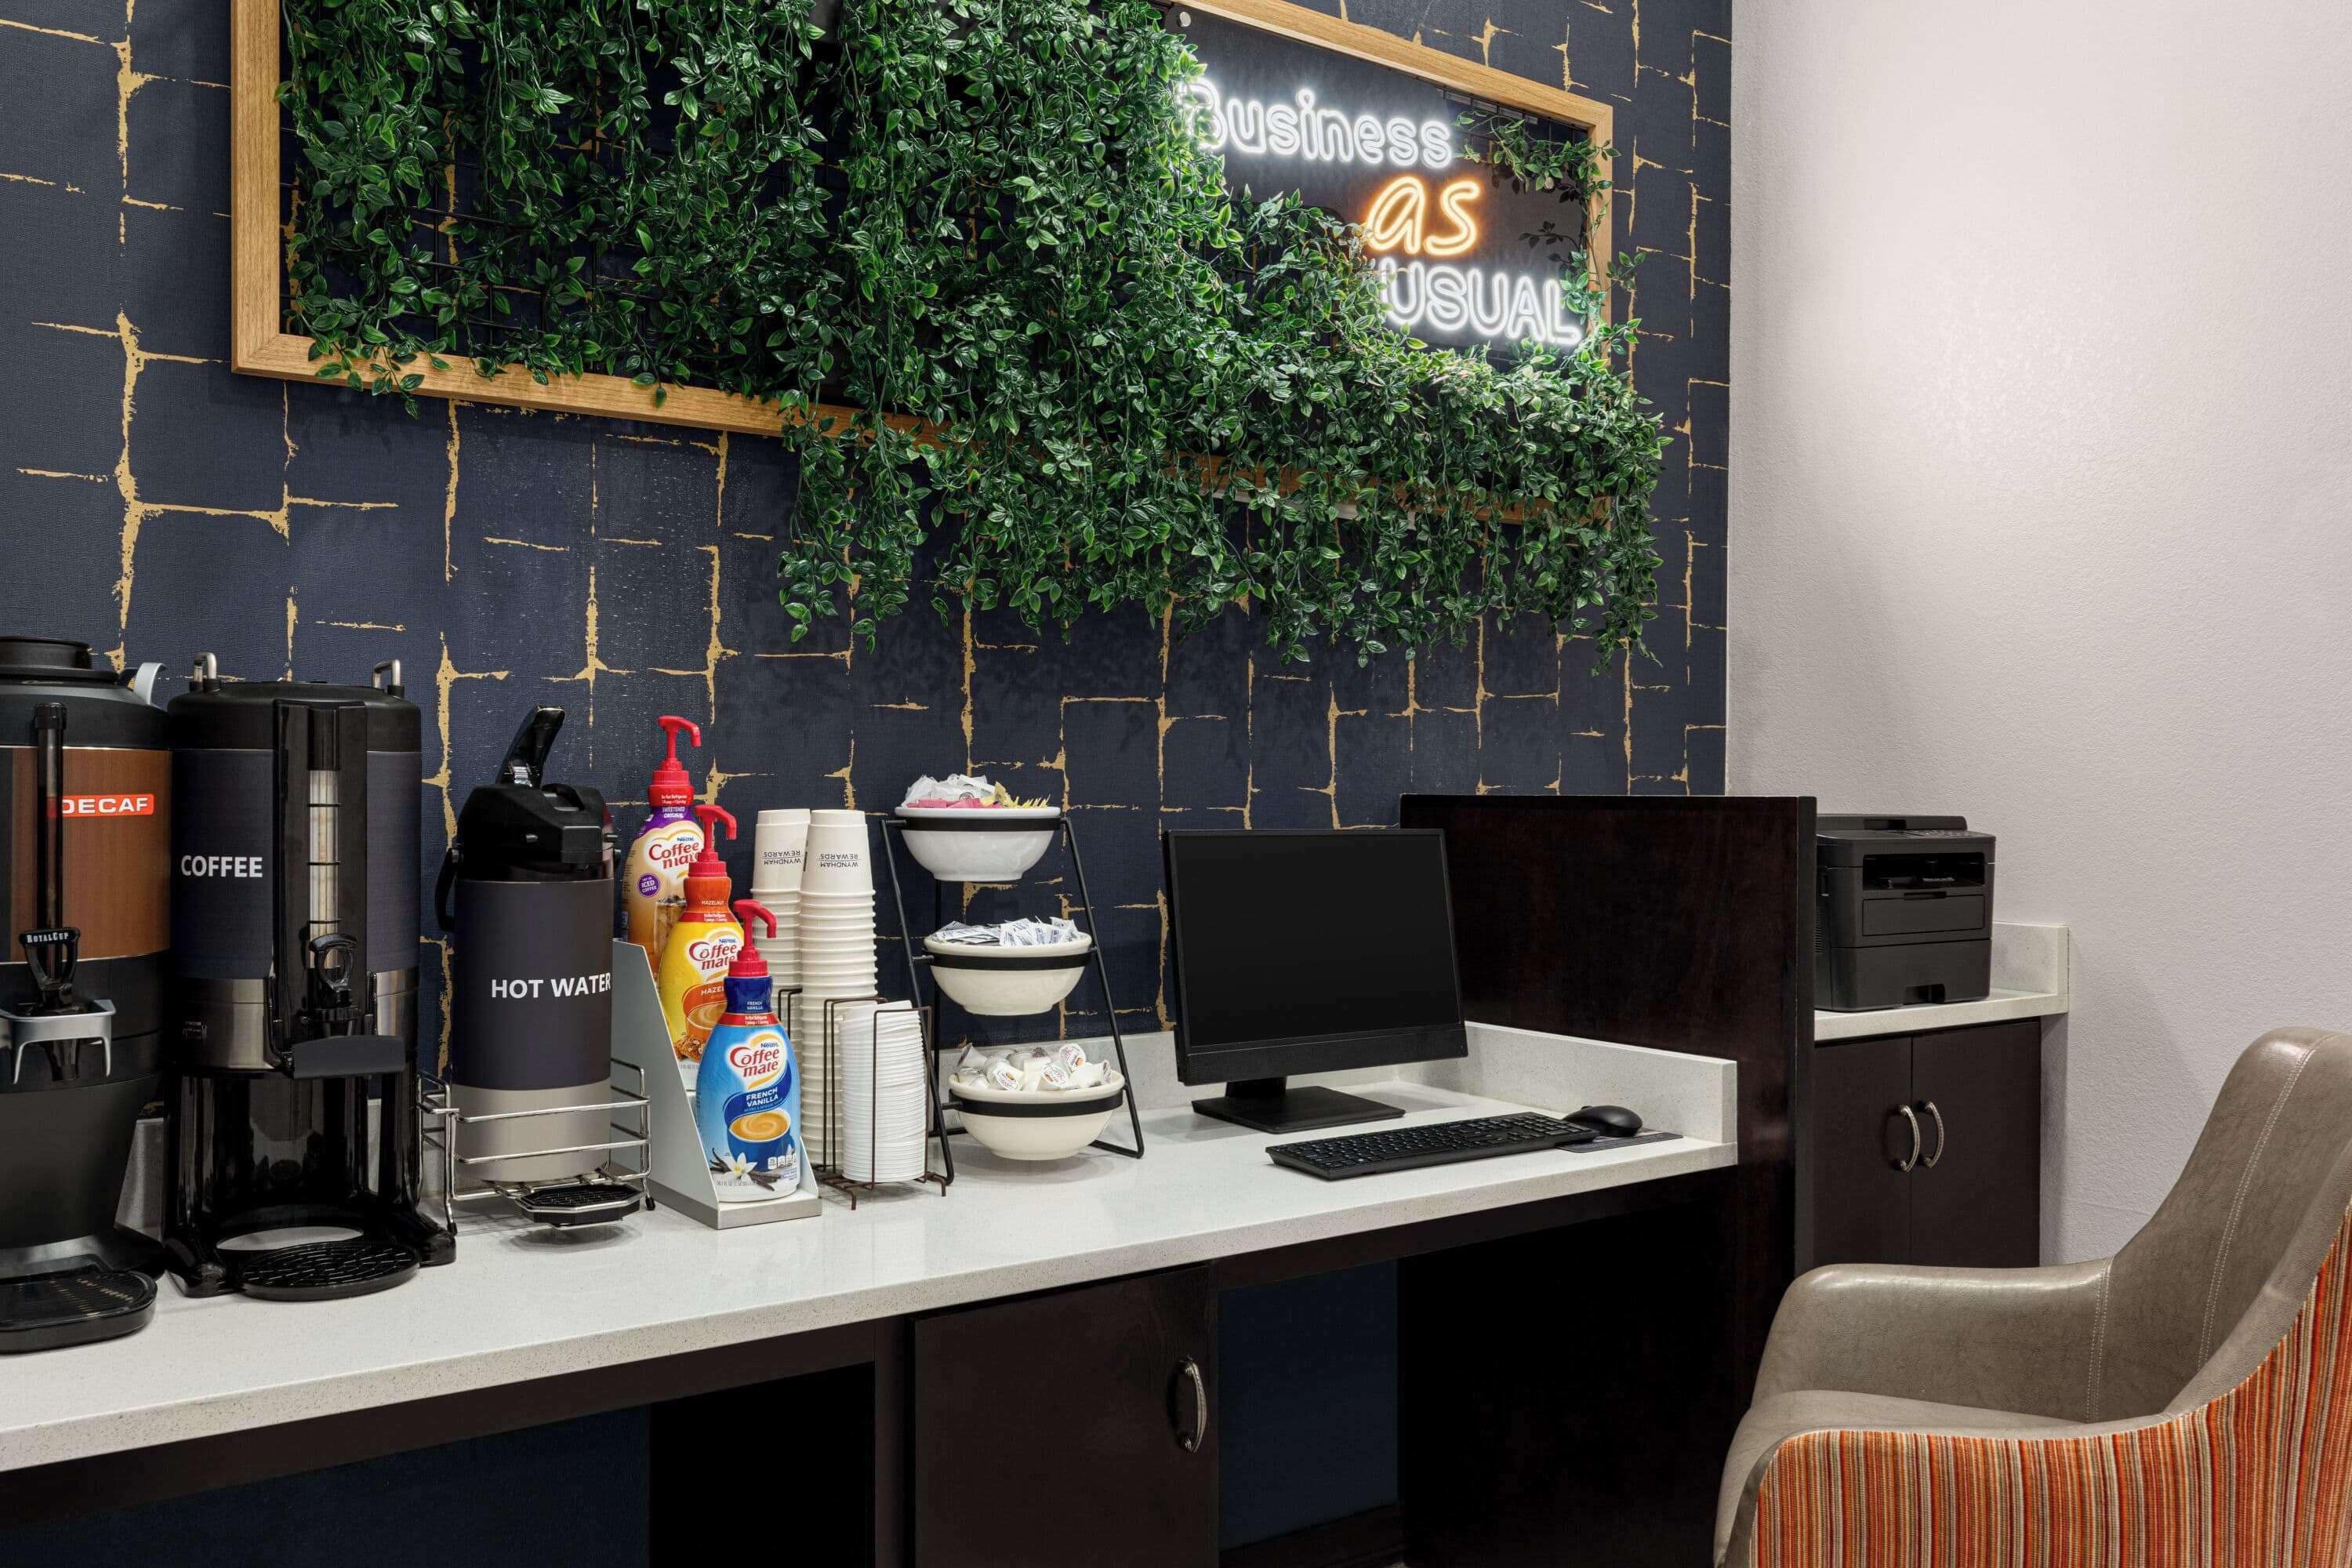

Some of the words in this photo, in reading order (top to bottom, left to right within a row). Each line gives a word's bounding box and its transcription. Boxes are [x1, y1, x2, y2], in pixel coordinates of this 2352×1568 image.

[1178, 77, 1452, 169] Business
[1367, 176, 1480, 256] as
[1378, 256, 1582, 345] USUAL
[62, 797, 148, 814] DECAF
[648, 843, 699, 861] Coffee
[181, 855, 263, 877] COFFEE
[689, 941, 737, 961] Coffee
[491, 979, 544, 998] HOT
[550, 972, 611, 997] WATER
[729, 1046, 779, 1068] Coffee
[743, 1061, 779, 1078] mate
[746, 1087, 778, 1102] FRENCH
[746, 1094, 779, 1107] VANILLA
